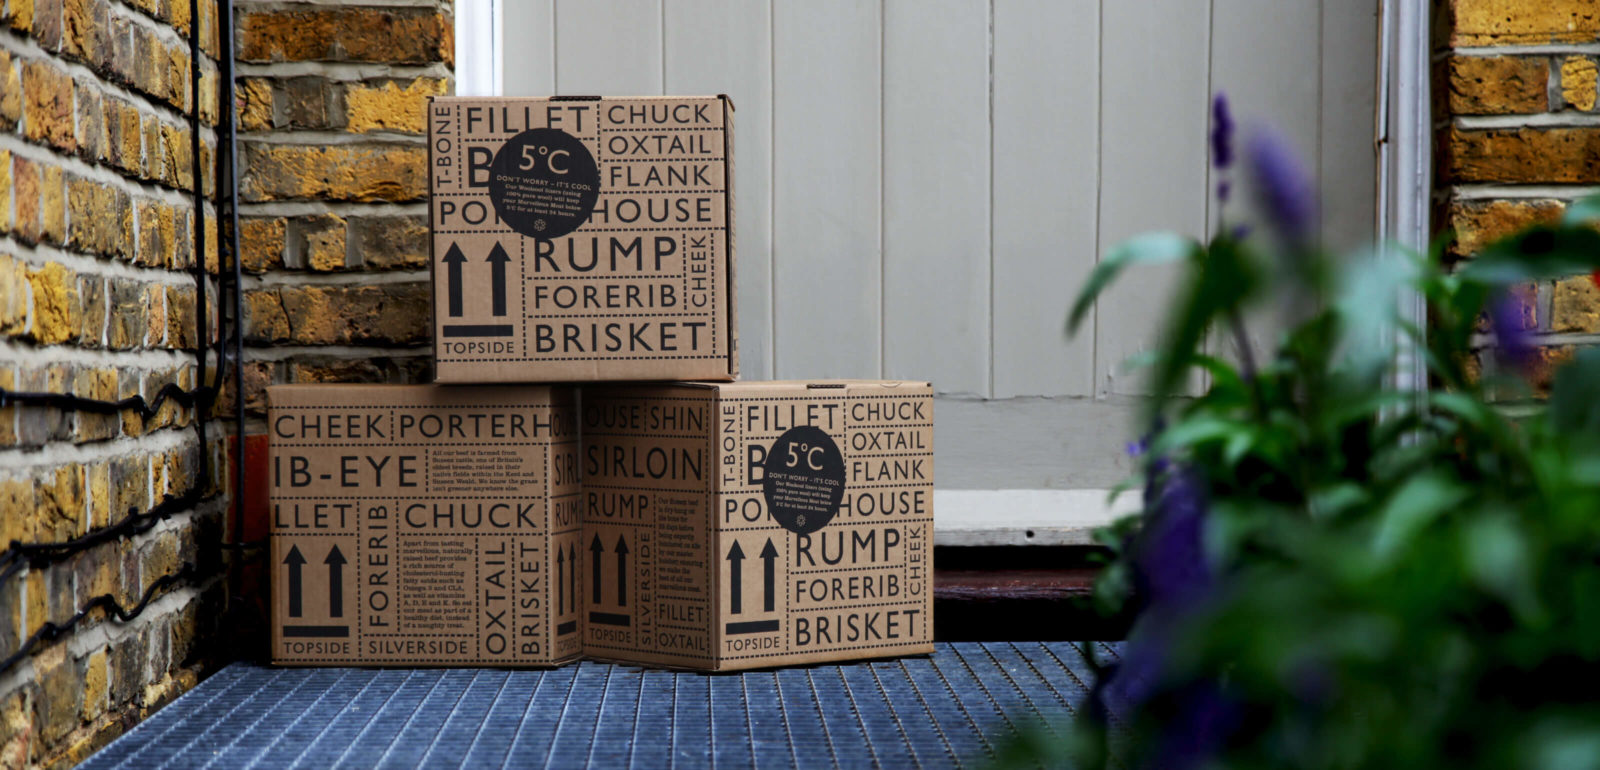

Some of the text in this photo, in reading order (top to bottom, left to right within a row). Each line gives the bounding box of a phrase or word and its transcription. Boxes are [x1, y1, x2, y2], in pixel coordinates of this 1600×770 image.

[466, 106, 590, 134] FILLET
[607, 104, 711, 125] CHUCK
[435, 107, 453, 188] T-BONE
[608, 135, 712, 155] OXTAIL
[519, 144, 570, 175] 5°C
[523, 178, 548, 186] WORRY
[610, 165, 712, 186] FLANK
[534, 236, 677, 273] RUMP
[691, 235, 707, 307] CHEEK
[535, 284, 677, 309] FORERIB
[443, 342, 514, 354] TOPSIDE
[535, 322, 706, 353] BRISKET
[651, 405, 703, 431] SHIN
[747, 404, 838, 431] FILLET
[851, 401, 924, 421] CHUCK
[274, 414, 387, 439] CHEEK
[722, 405, 736, 486] T-BONE
[852, 430, 925, 451] OXTAIL
[588, 444, 702, 480] SIRLOIN
[786, 442, 824, 470] 5°C
[853, 459, 924, 482] FLANK
[405, 503, 537, 529] CHUCK
[589, 492, 649, 519] RUMP
[796, 528, 901, 567] RUMP
[909, 527, 921, 595] CHEEK
[369, 505, 389, 627] FORERIB
[485, 541, 507, 655] OXTAIL
[521, 542, 540, 655] BRISKET
[641, 532, 650, 646] SILVERSIDE
[796, 575, 899, 603] FORERIB
[659, 603, 704, 623] FILLET
[590, 628, 631, 643] TOPSIDE
[659, 633, 705, 650] OXTAIL
[796, 610, 920, 646] BRISKET
[284, 642, 350, 654] TOPSIDE
[369, 640, 468, 655] SILVERSIDE
[726, 636, 780, 651] TOPSIDE
